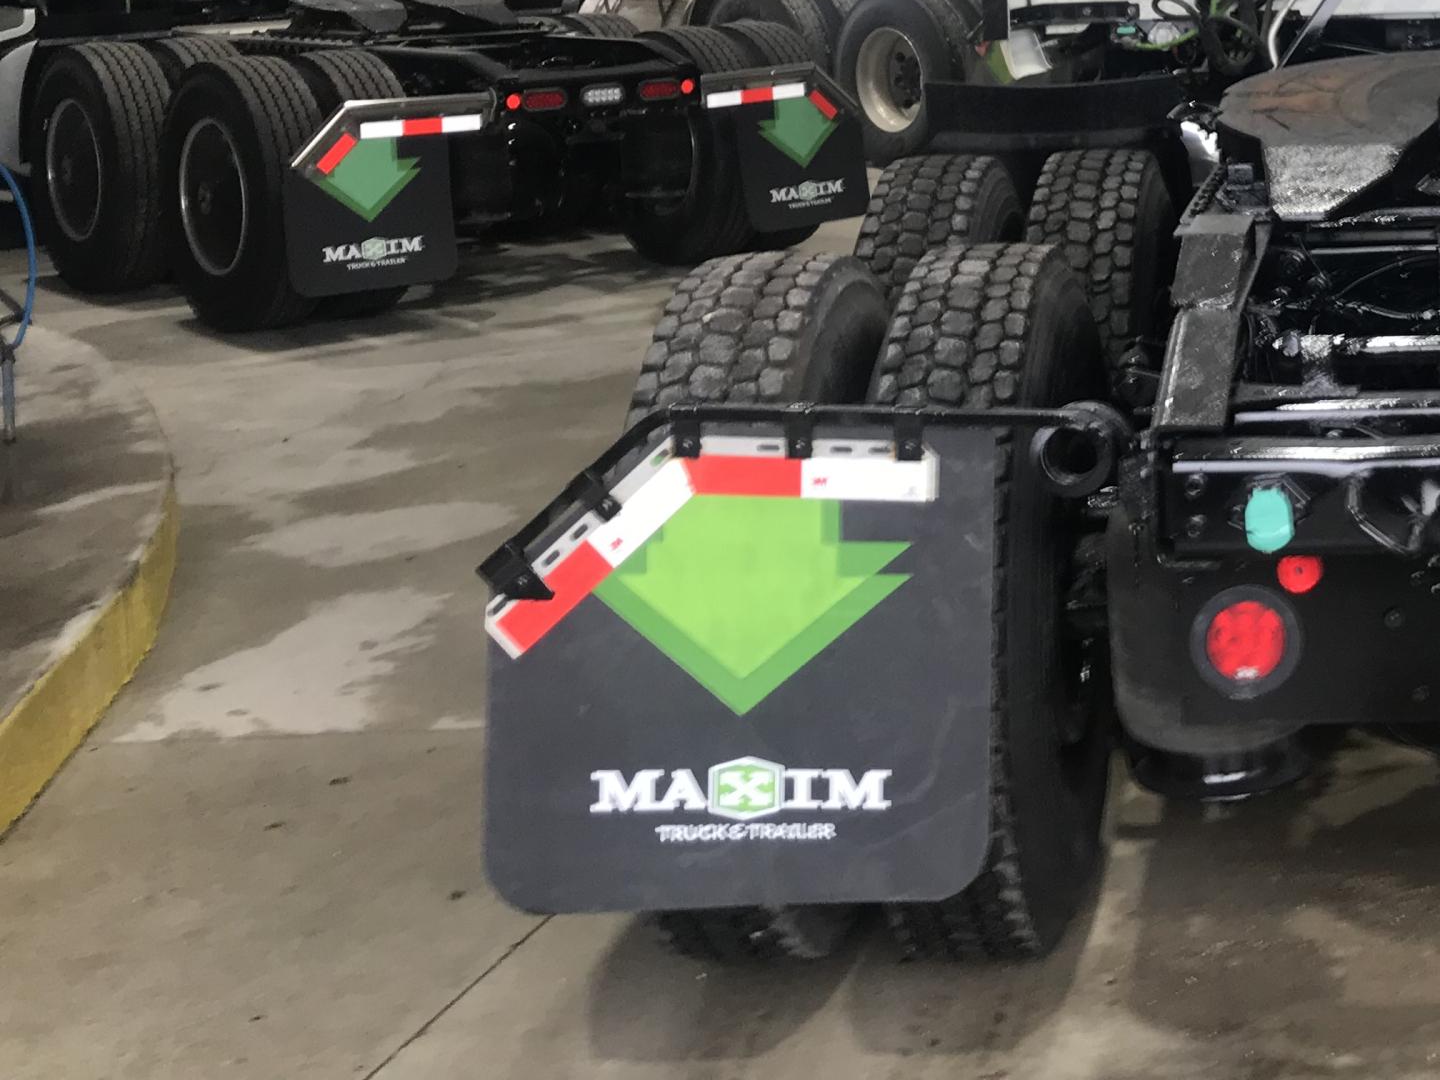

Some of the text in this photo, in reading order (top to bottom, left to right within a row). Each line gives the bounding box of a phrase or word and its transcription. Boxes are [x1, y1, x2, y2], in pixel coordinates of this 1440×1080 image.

[768, 178, 845, 203] MAXIM
[321, 235, 425, 263] MAXIM
[589, 755, 893, 821] MAXIM
